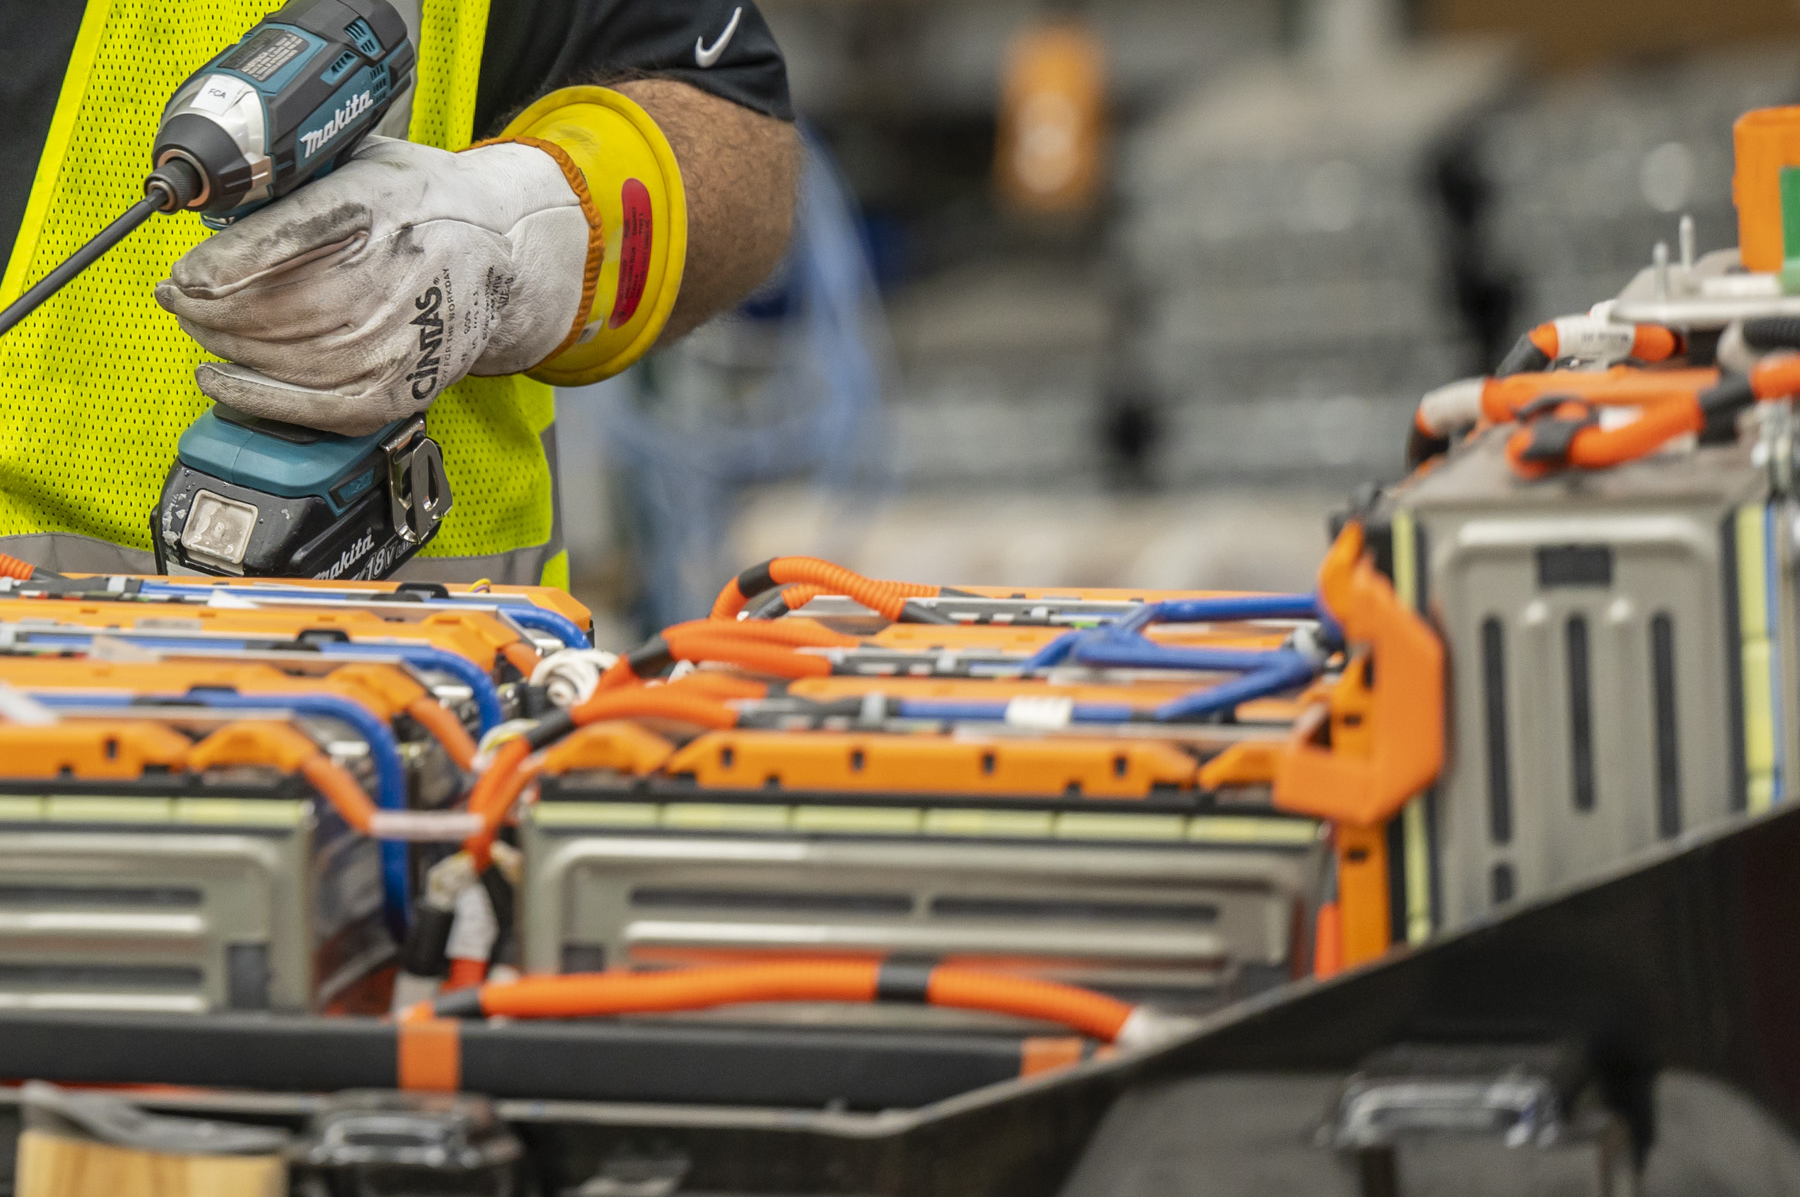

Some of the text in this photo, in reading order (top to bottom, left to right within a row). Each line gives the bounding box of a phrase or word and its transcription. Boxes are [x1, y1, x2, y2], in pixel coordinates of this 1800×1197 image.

[207, 87, 226, 99] FCA
[443, 268, 456, 322] WORKDAY
[447, 324, 455, 344] THE
